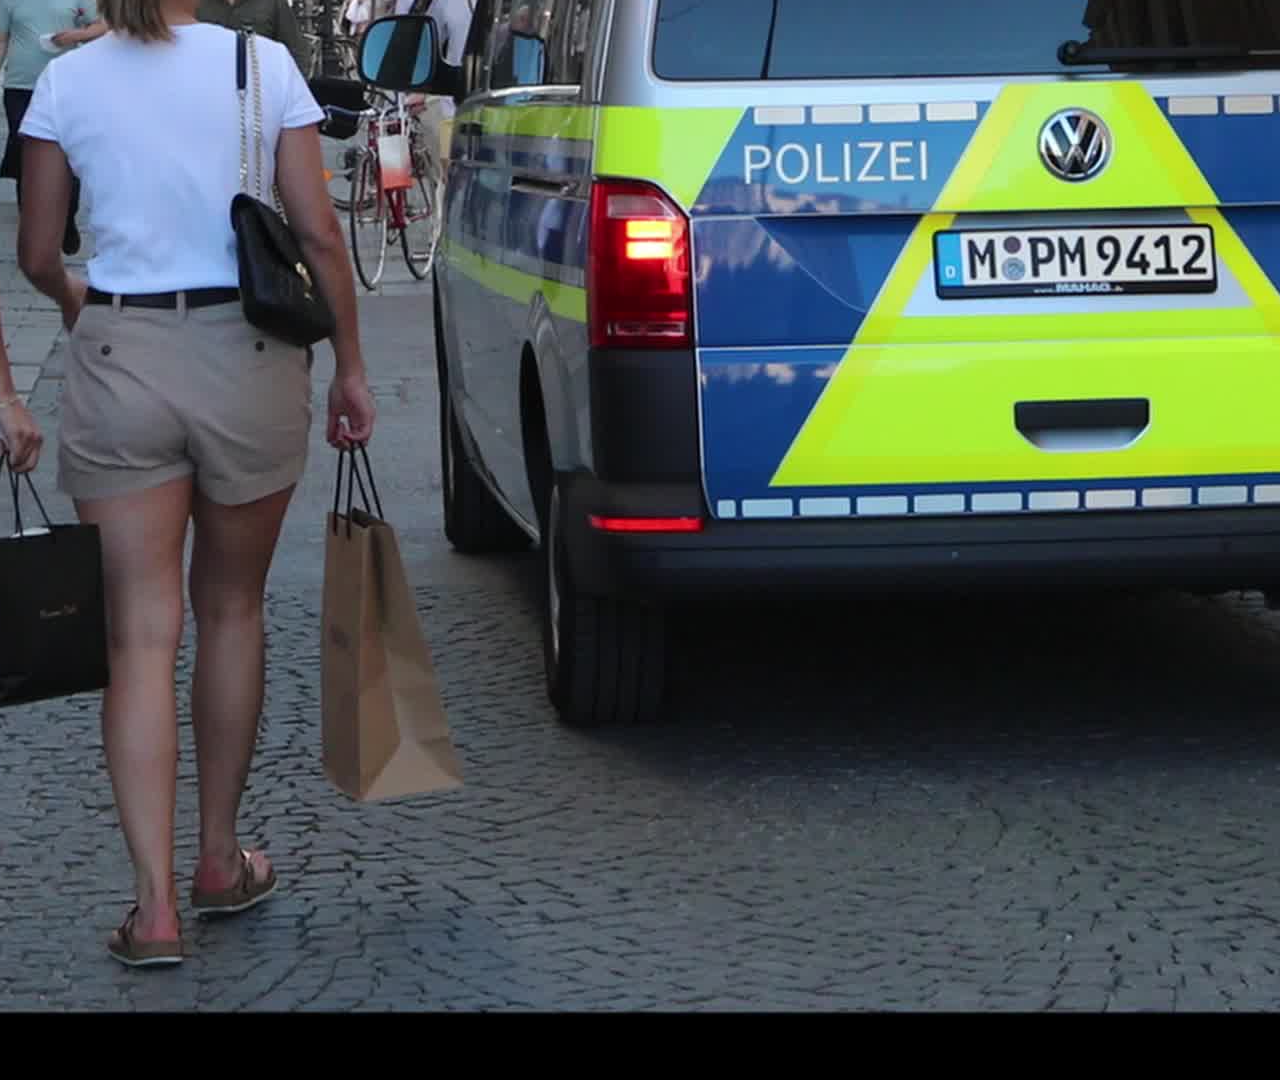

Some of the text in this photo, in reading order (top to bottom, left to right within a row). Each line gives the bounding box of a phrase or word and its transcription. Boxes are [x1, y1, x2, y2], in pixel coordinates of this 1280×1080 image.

[743, 140, 928, 185] POLIZEI
[967, 234, 1207, 280] M PM 9412
